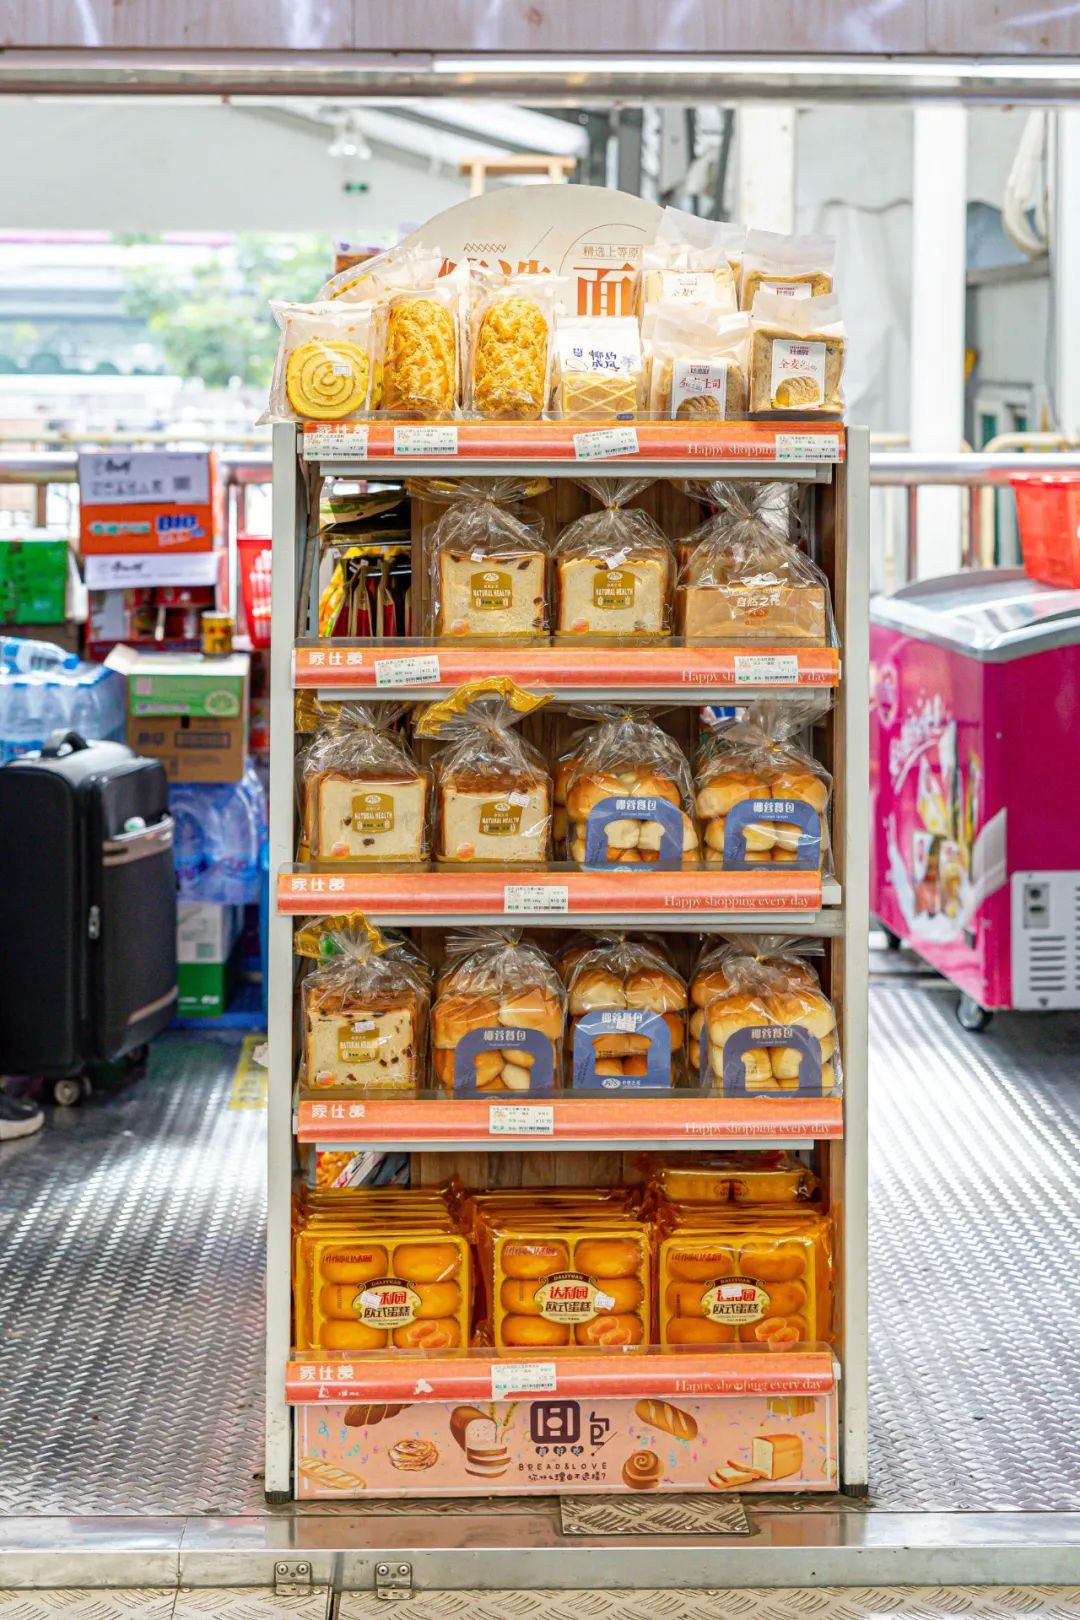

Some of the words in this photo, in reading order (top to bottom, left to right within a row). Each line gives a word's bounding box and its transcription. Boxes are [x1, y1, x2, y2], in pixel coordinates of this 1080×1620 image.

[687, 443, 724, 457] Happy
[728, 443, 776, 457] shoppin
[681, 670, 719, 683] Happy
[808, 670, 827, 683] day
[664, 894, 701, 909] Happy
[704, 894, 756, 909] shopping
[758, 896, 787, 907] every
[790, 893, 810, 908] day
[684, 1121, 721, 1135] Happy
[726, 1121, 776, 1135] shopping
[779, 1122, 808, 1134] every
[811, 1121, 830, 1133] day
[379, 1291, 407, 1305] 利园
[549, 1286, 589, 1300] 达利园
[364, 1306, 410, 1319] 欧式蛋糕
[545, 1301, 592, 1313] 欧式蛋糕
[712, 1303, 759, 1315] 欧式蛋糕
[675, 1379, 714, 1393] Happy
[769, 1379, 799, 1391] every
[802, 1378, 824, 1390] day
